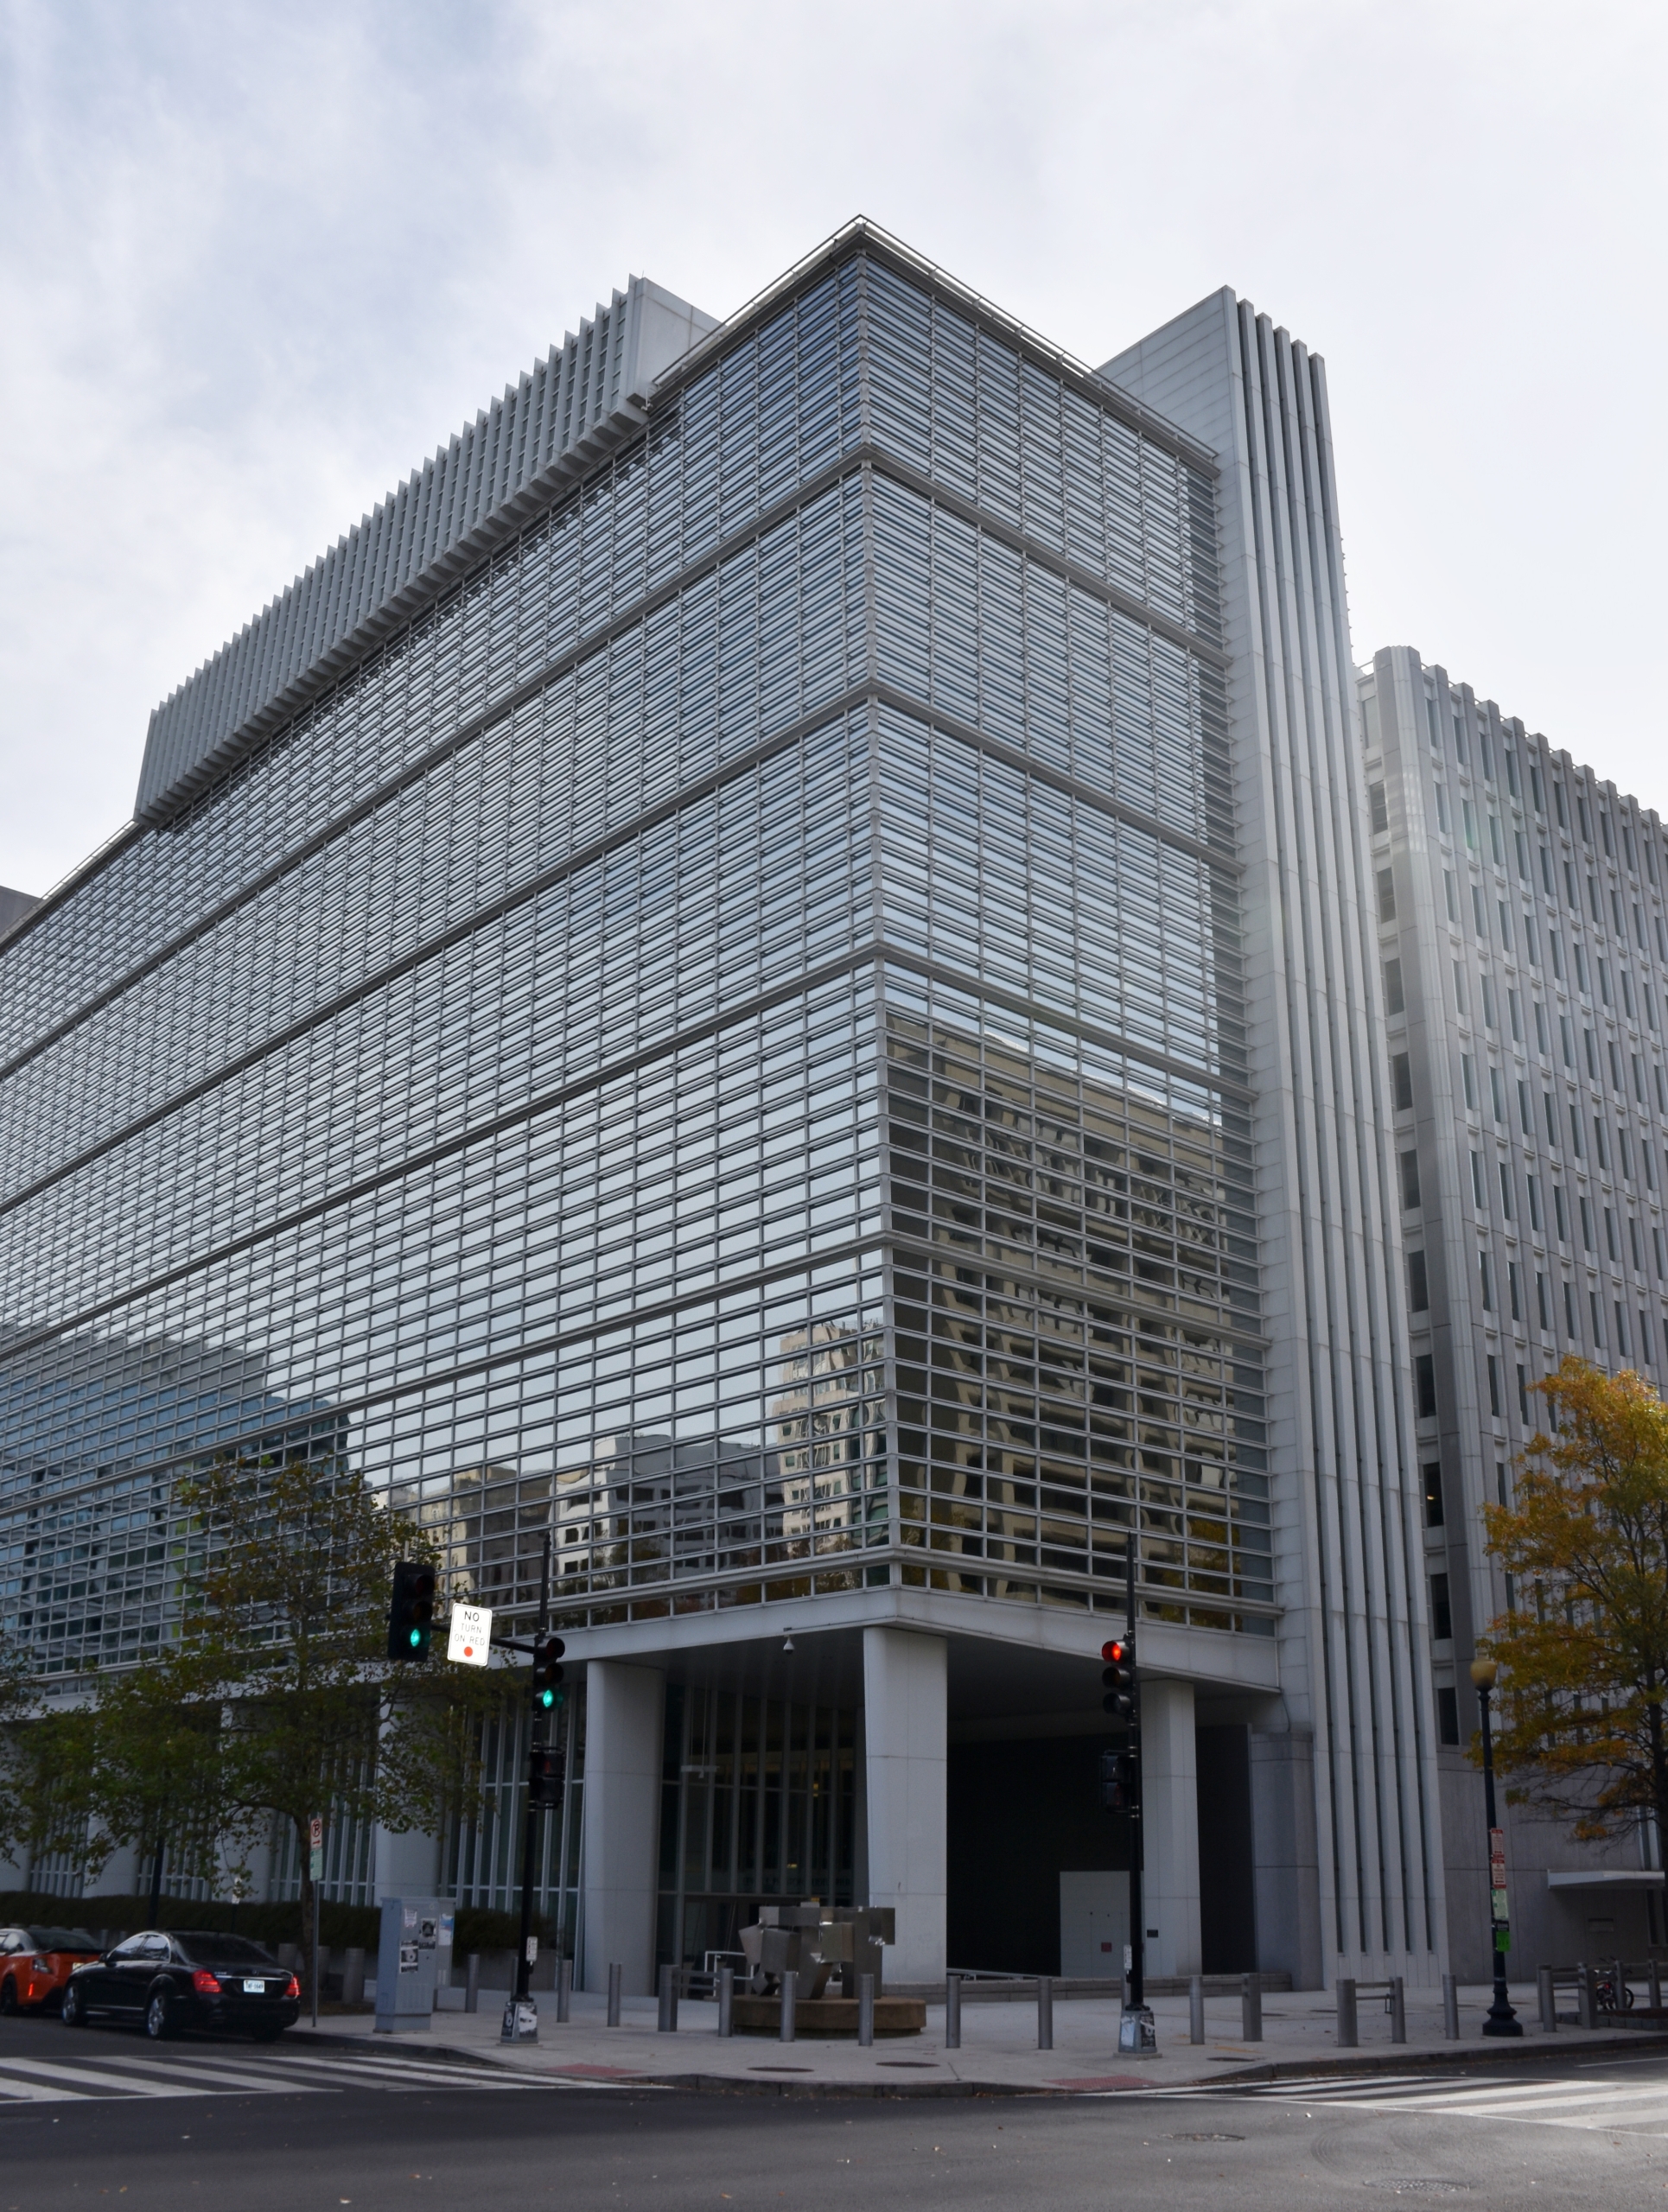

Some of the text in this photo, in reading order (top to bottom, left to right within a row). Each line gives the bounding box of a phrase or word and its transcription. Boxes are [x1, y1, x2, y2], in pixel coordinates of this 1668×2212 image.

[464, 1611, 480, 1622] NO
[462, 1623, 482, 1634] TURN
[454, 1633, 486, 1646] ON RED
